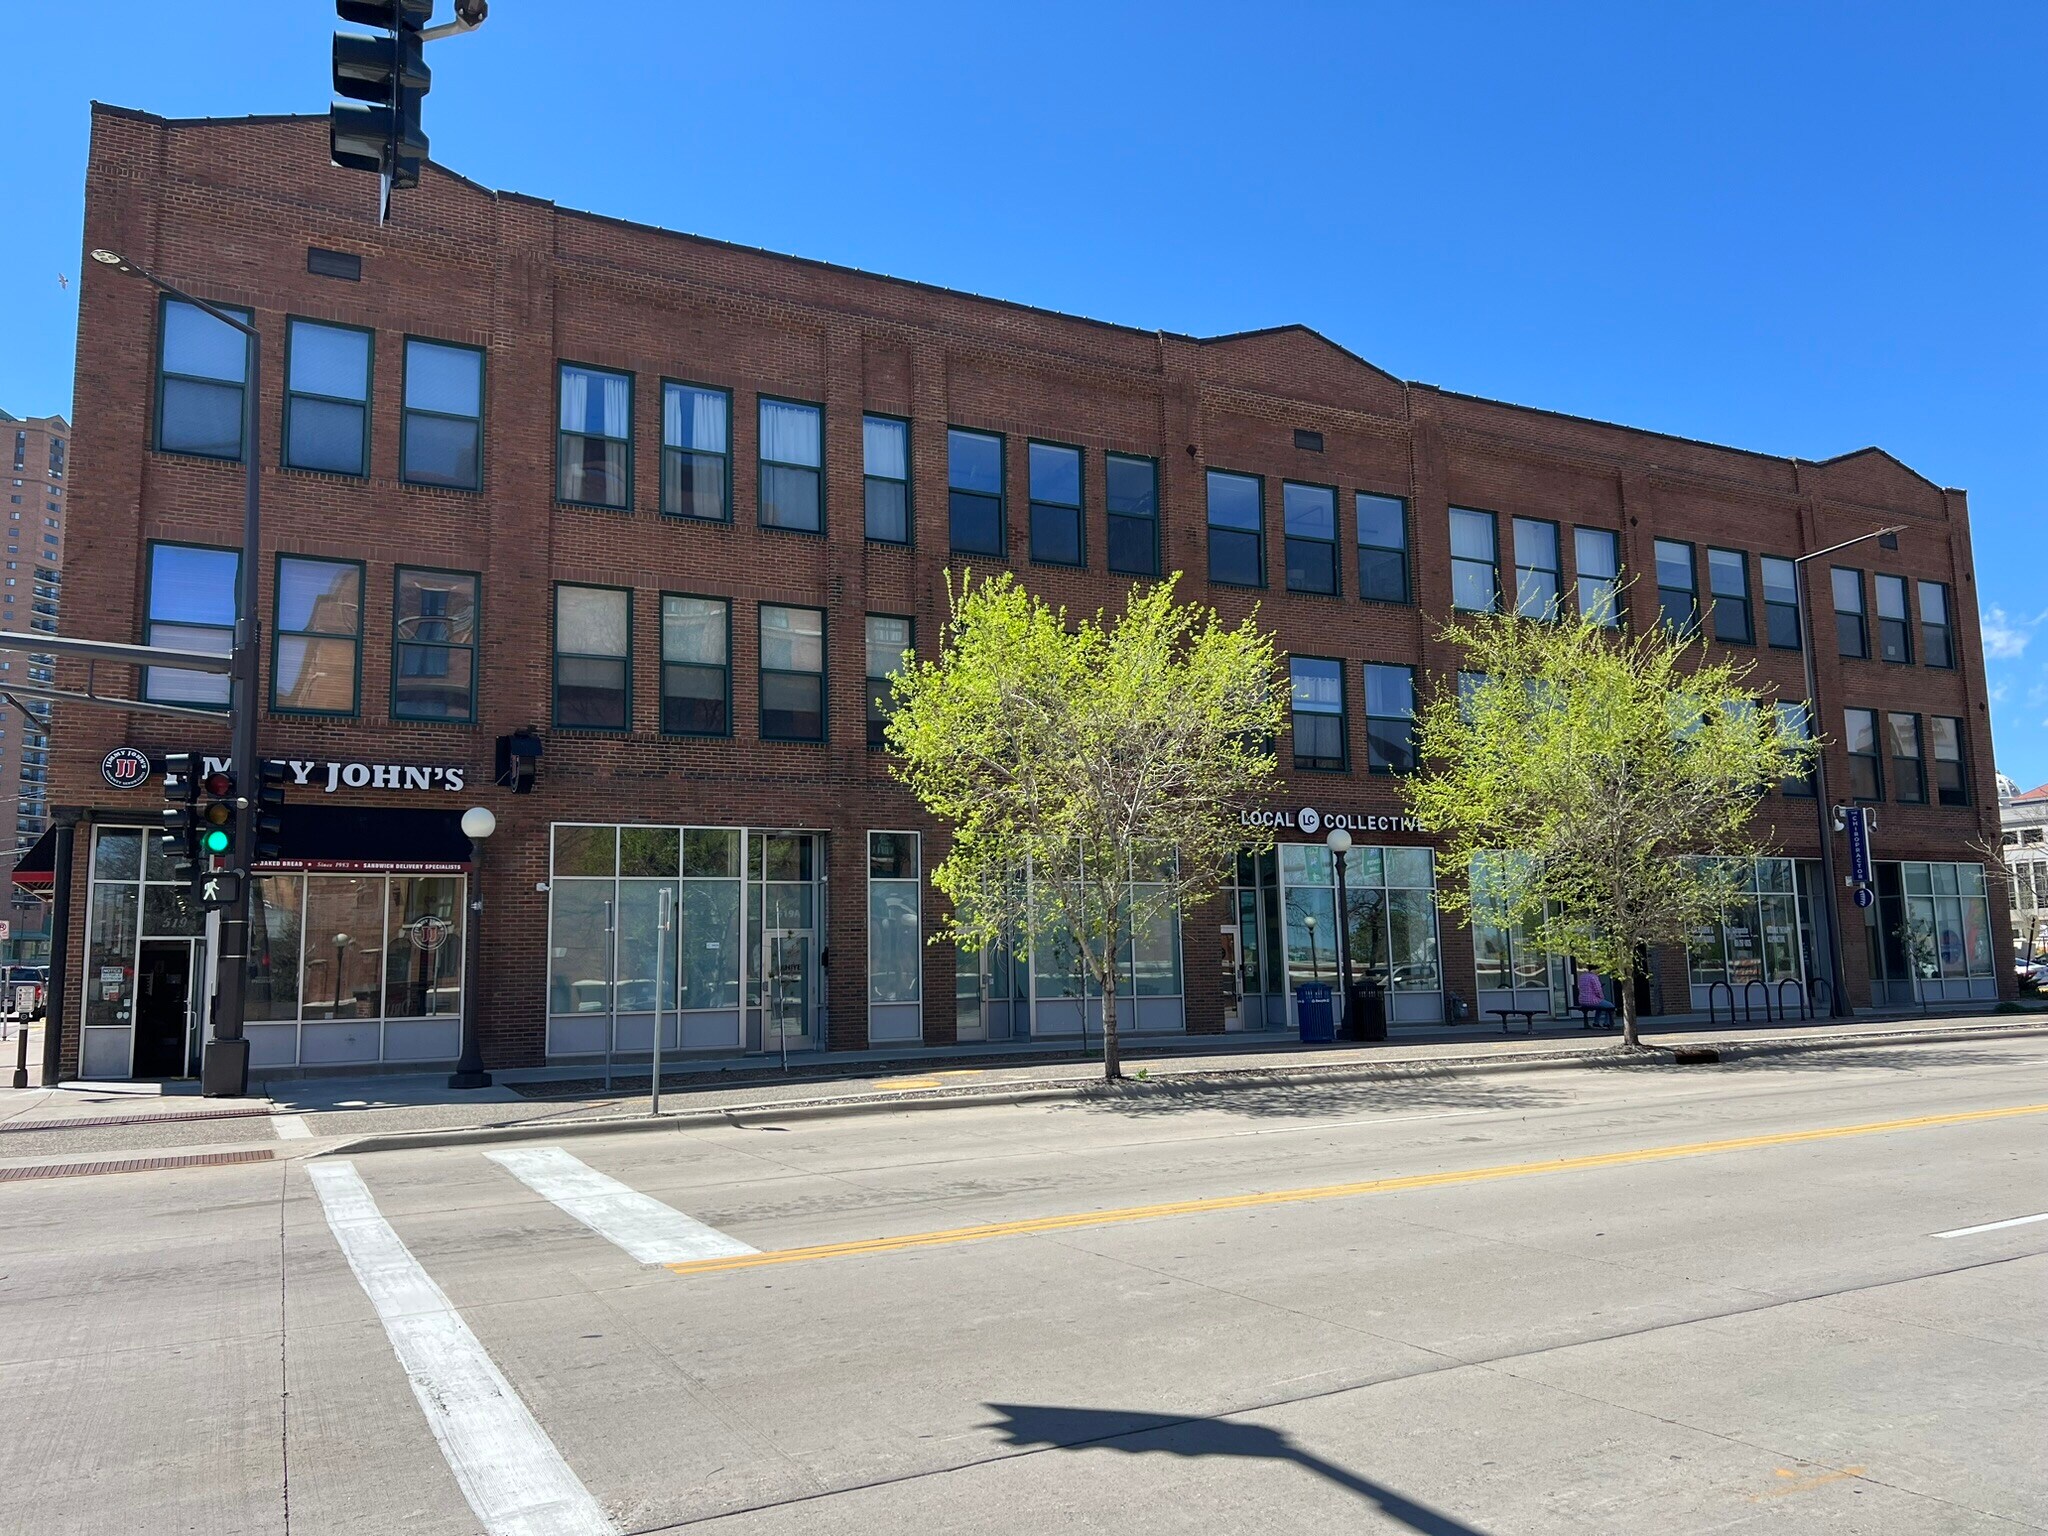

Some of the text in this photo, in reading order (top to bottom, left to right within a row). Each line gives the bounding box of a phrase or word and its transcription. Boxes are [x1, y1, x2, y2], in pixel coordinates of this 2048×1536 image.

[115, 759, 138, 778] JJ
[325, 762, 465, 793] JOHN'S
[1241, 810, 1295, 828] LOCAL
[1303, 814, 1316, 826] LC
[1852, 815, 1863, 879] CHIROPRACTOR
